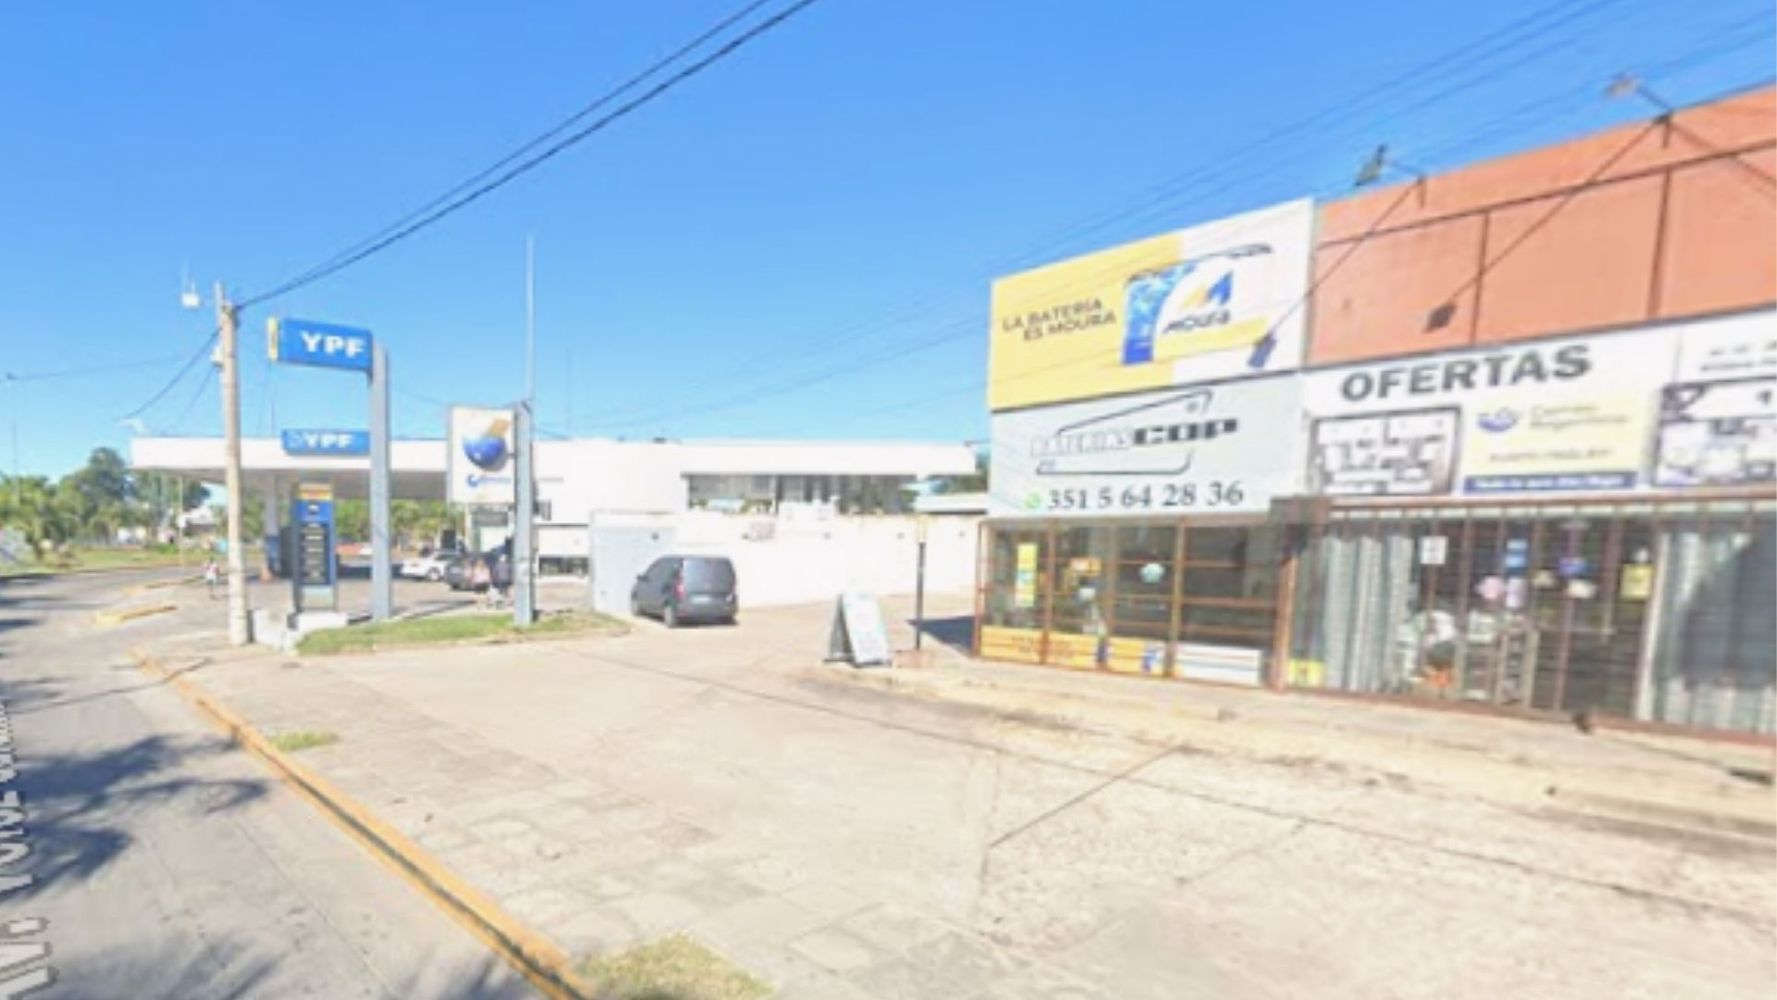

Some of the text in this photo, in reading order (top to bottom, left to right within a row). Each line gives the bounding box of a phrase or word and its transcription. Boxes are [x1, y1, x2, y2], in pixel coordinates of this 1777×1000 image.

[1002, 315, 1024, 332] LA
[1024, 309, 1117, 341] ES MOURA
[300, 329, 366, 358] YPF
[1340, 344, 1593, 402] OFERTAS
[303, 432, 354, 449] YPF
[1047, 479, 1245, 510] 351 5 64 28 36
